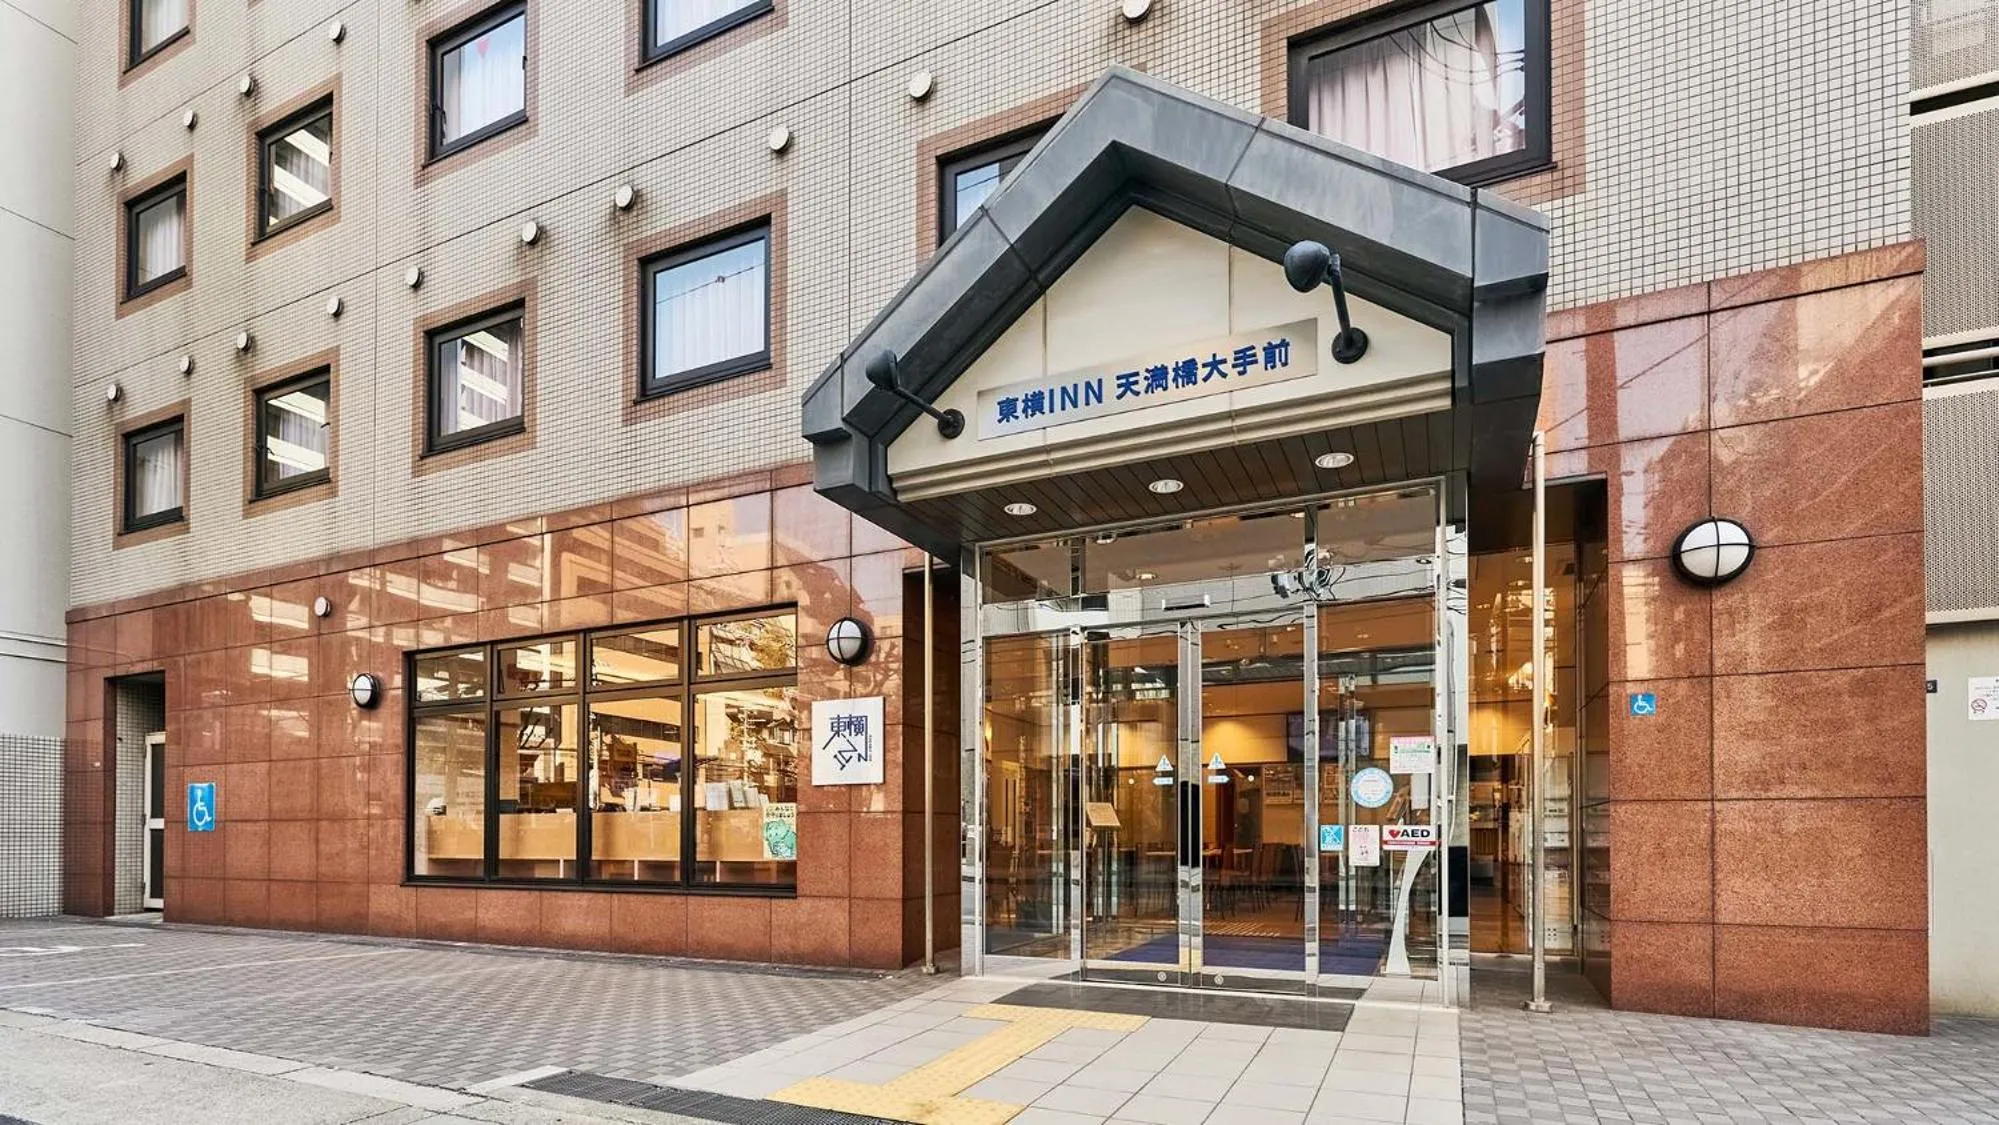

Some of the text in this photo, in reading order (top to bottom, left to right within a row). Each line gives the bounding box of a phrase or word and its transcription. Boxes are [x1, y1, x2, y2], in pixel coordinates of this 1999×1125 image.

[996, 338, 1291, 424] 東横INN 天満橋大手前
[1400, 829, 1431, 838] AED
